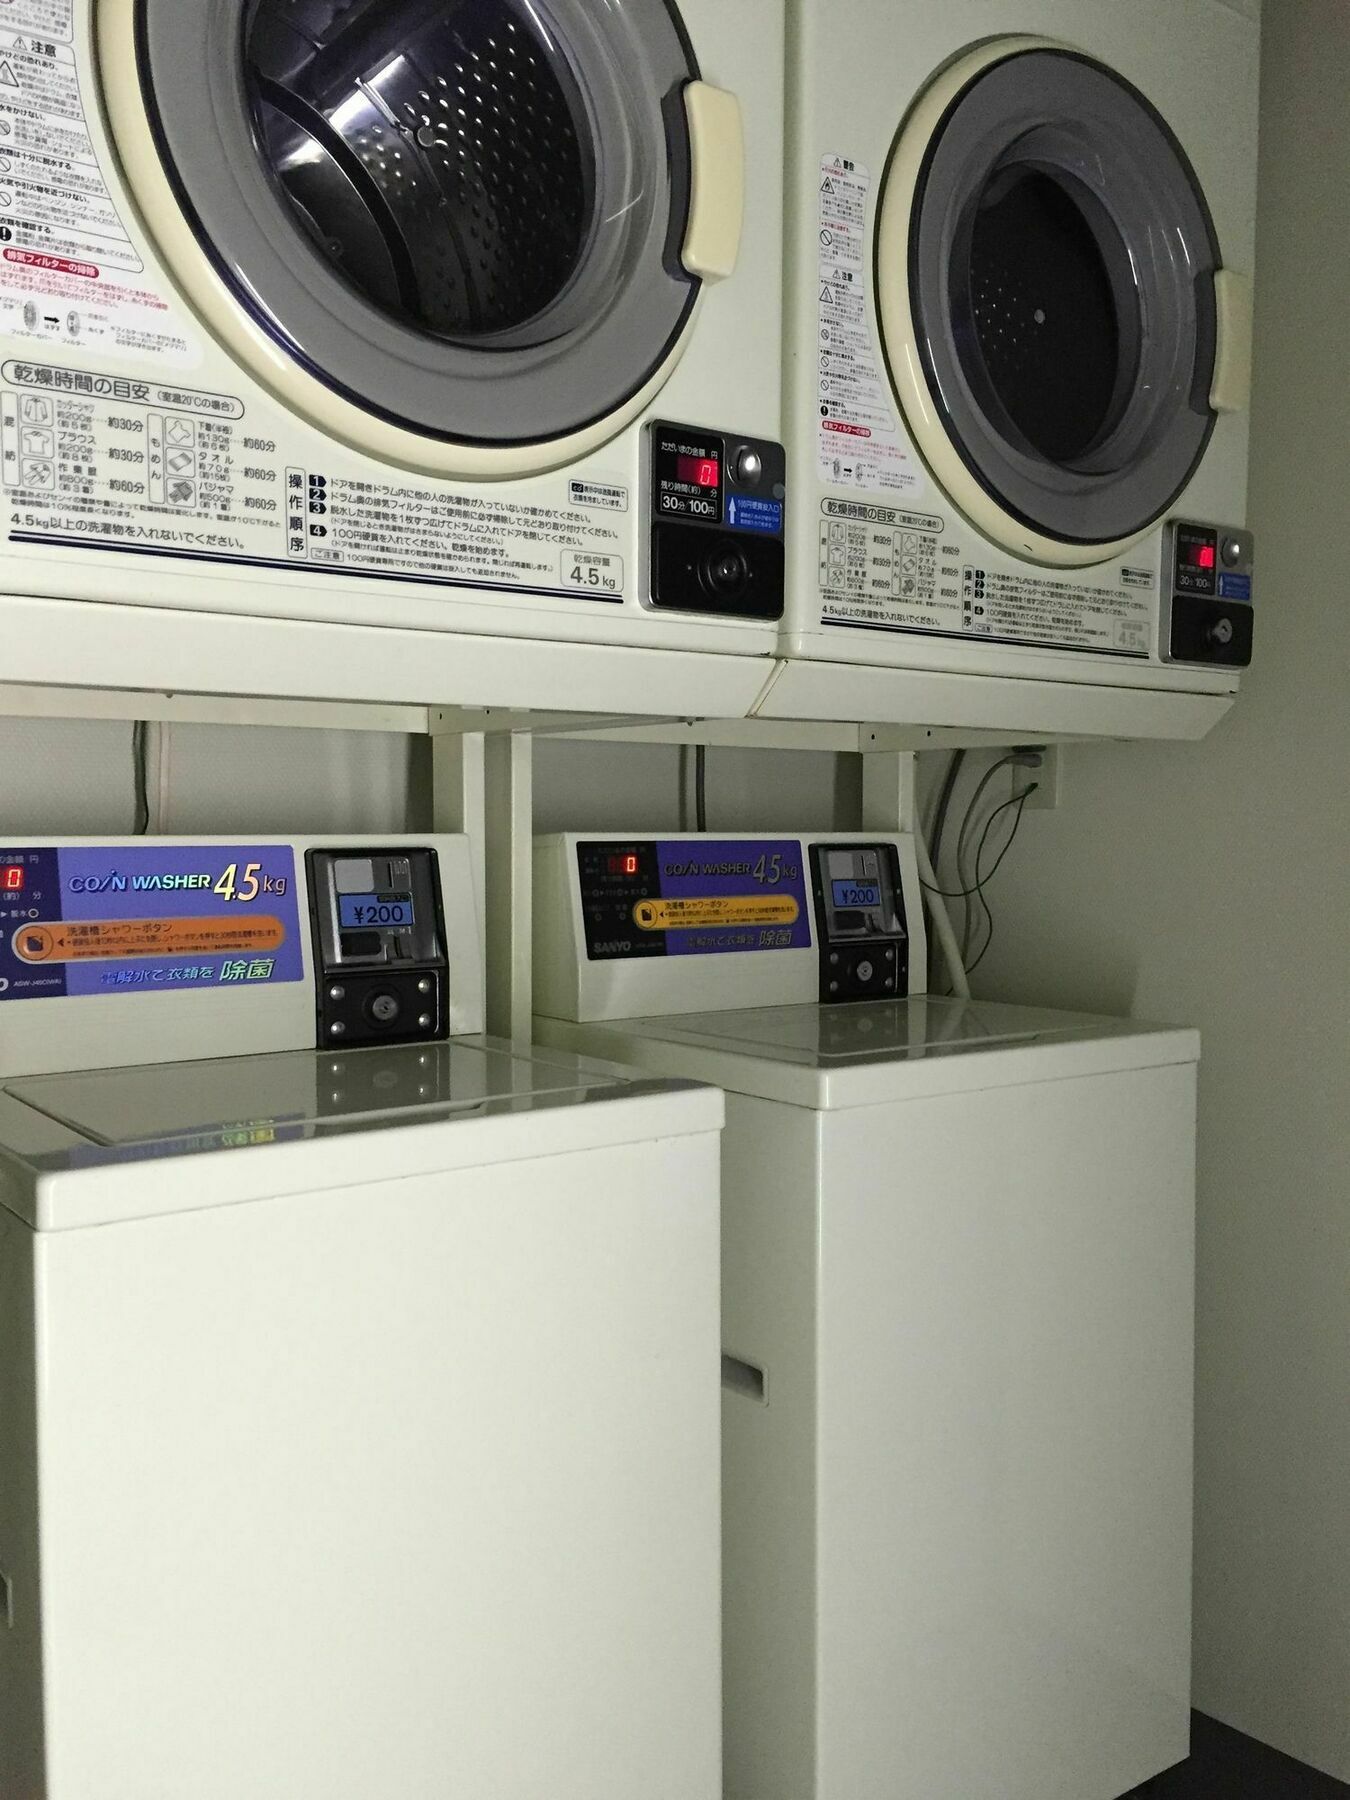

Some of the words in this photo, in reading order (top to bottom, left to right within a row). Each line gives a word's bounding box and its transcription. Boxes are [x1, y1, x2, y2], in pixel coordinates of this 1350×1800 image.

[31, 40, 57, 58] 注意
[7, 252, 96, 276] 排気フィルターの掃除
[14, 364, 150, 401] 乾燥時間の目安
[107, 415, 143, 433] 約30分
[243, 435, 276, 453] 約60分
[108, 447, 144, 464] 約30分
[711, 450, 718, 459] 円
[244, 466, 277, 482] 約60分
[700, 464, 711, 485] 0
[109, 479, 145, 495] 約60分
[710, 488, 718, 498] 分
[244, 496, 278, 512] 約60分
[827, 501, 897, 523] 乾燥時間の目安
[288, 474, 304, 552] 操作順序
[11, 513, 245, 549] 4.5kg以上の洗濯物を入れないでください。
[573, 553, 611, 567] 乾燥容量
[29, 855, 39, 865] 円
[626, 857, 636, 873] 0
[703, 863, 750, 875] WASHER
[7, 869, 22, 888] 0
[69, 869, 127, 893] COIN
[131, 874, 211, 890] WASHER
[842, 888, 874, 904] ¥200
[353, 905, 404, 924] ¥200
[67, 923, 173, 937] 洗濯槽シャワーボタン
[593, 940, 632, 953] SANYO
[219, 958, 276, 982] 除菌
